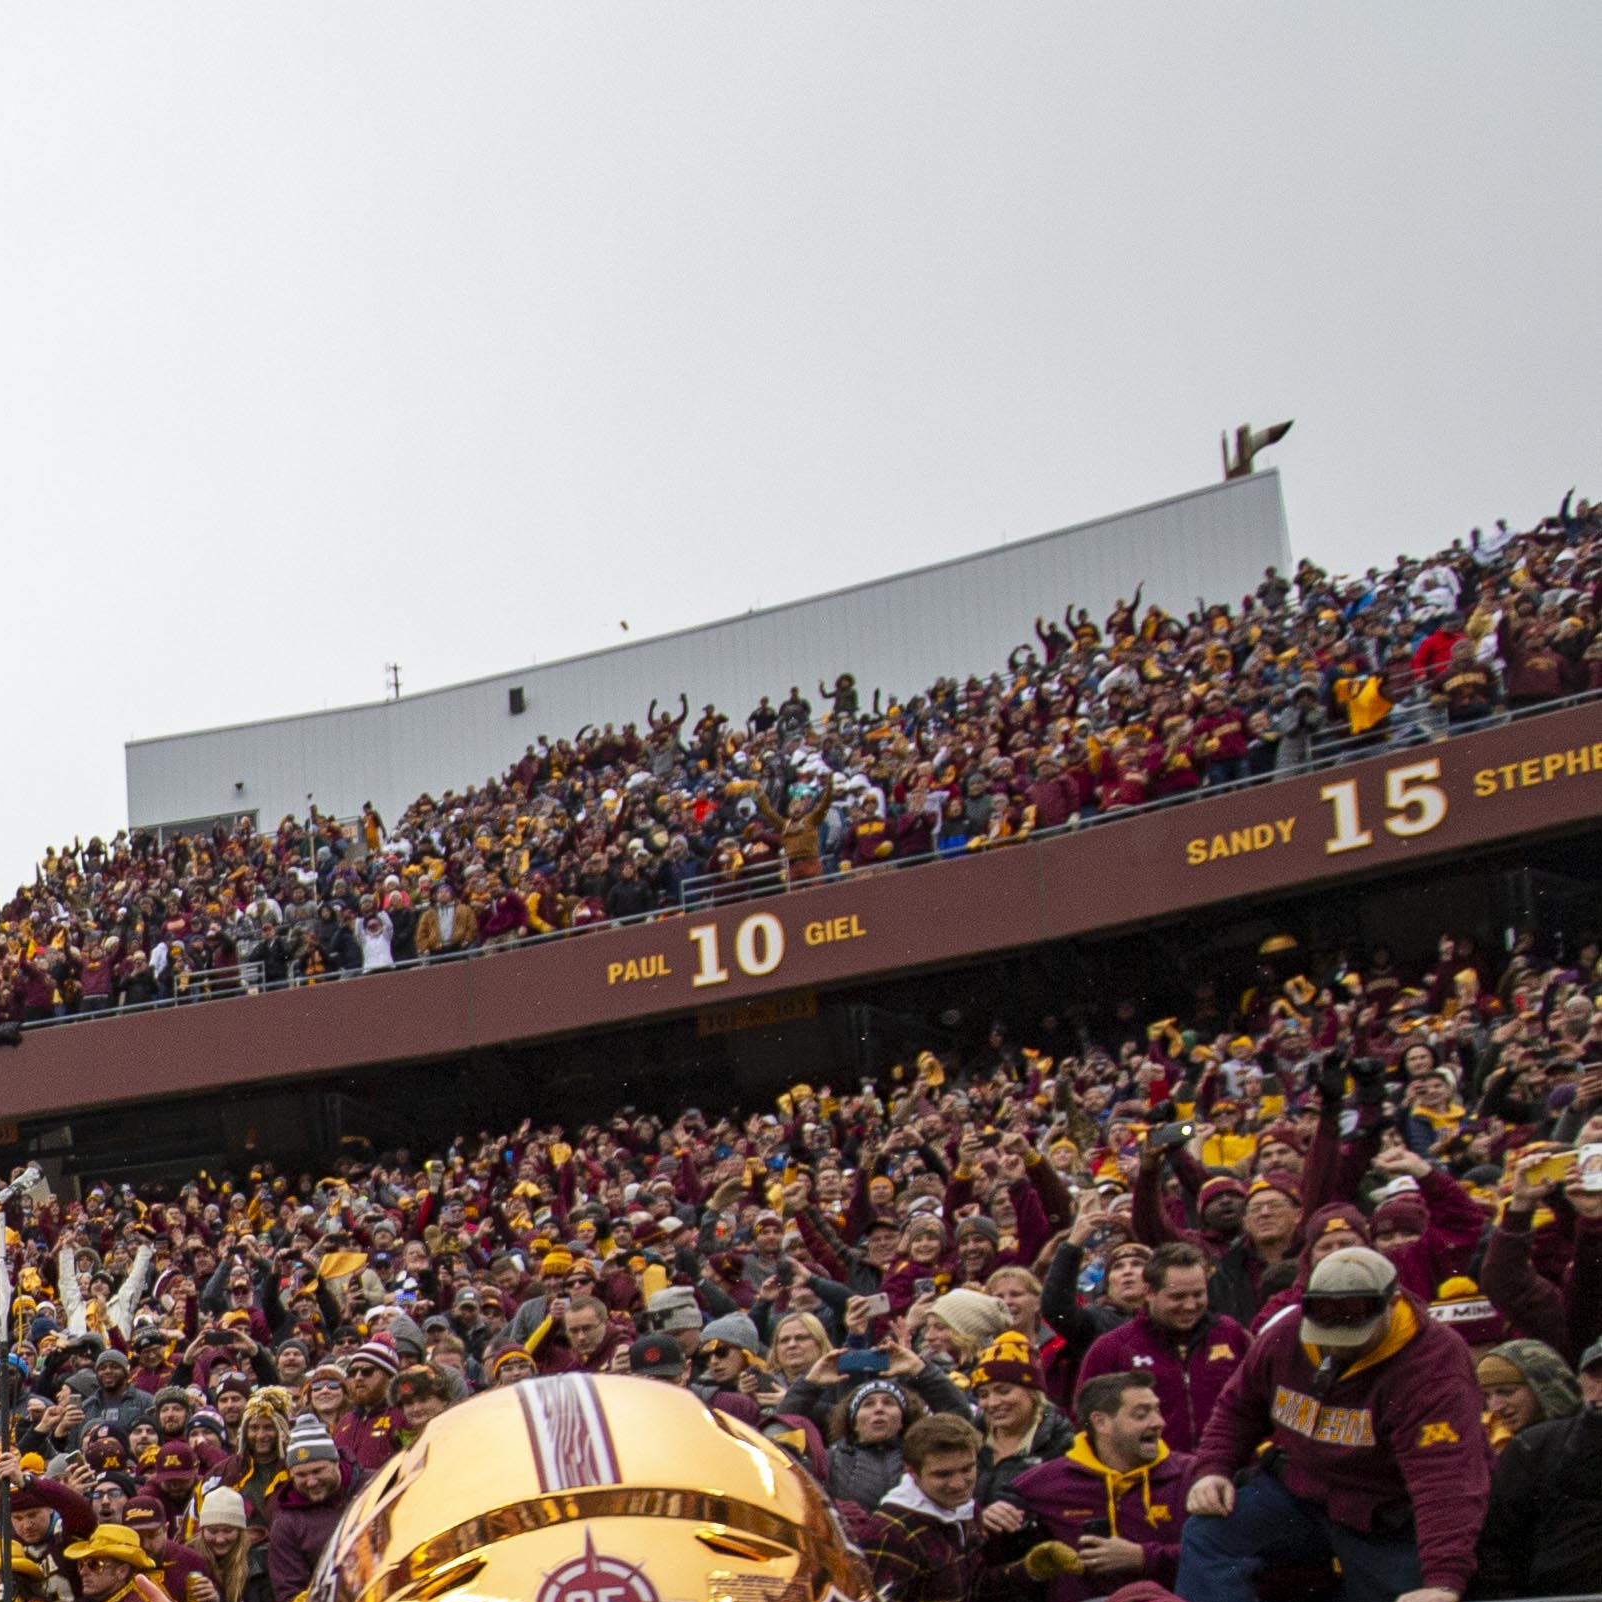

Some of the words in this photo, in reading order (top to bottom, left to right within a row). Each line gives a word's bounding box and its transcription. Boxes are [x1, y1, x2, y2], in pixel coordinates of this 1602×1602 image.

[1186, 816, 1296, 867] SANDY
[1319, 756, 1449, 855] 15
[606, 953, 673, 986] PAUL
[687, 911, 787, 988] 10
[803, 913, 867, 947] GIEL
